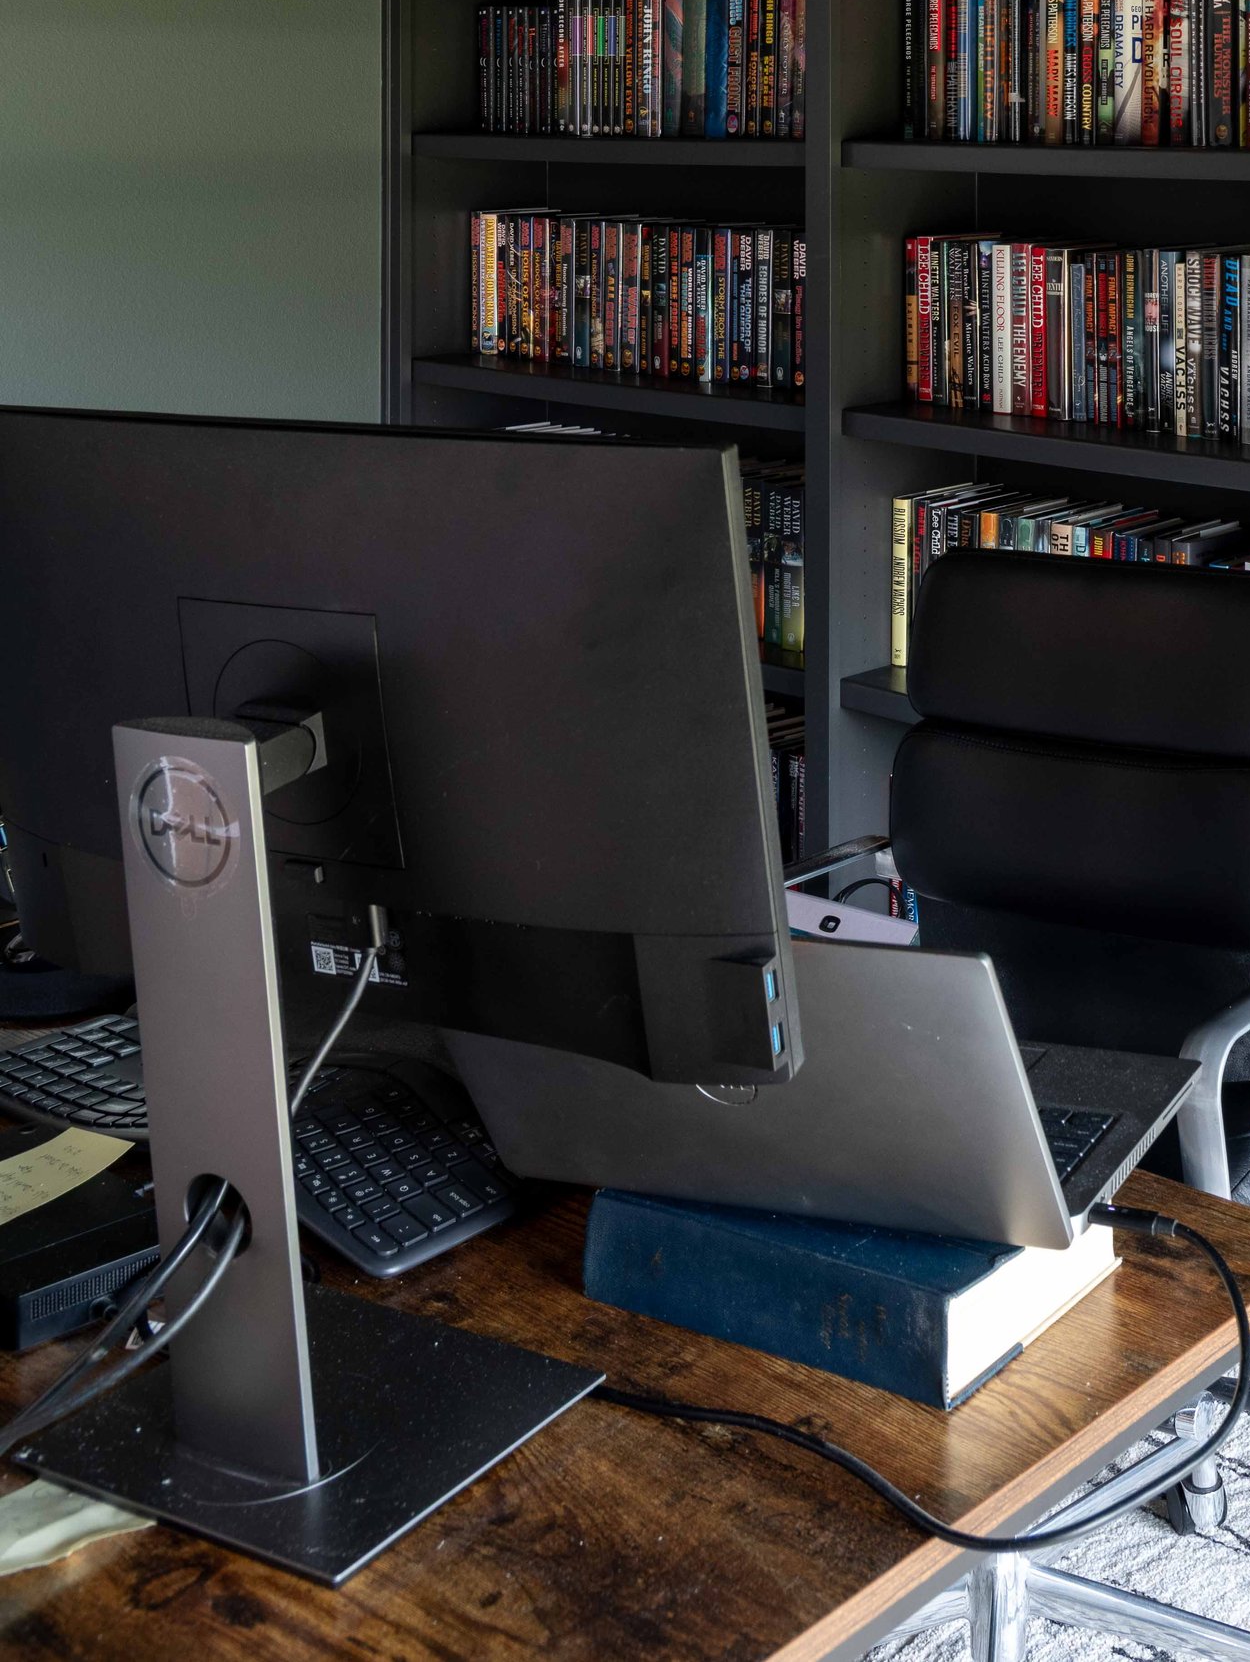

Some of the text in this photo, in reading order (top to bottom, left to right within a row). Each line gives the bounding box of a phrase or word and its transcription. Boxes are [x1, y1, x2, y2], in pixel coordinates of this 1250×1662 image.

[1115, 15, 1123, 88] DRAMA CITY
[1144, 6, 1154, 123] HARD REVOLUTION
[1170, 18, 1182, 128] SOUL CIRCUS
[1082, 83, 1092, 130] COUNTRY
[758, 265, 767, 353] ECHOES OF HONOR
[996, 249, 1004, 332] KILLING FLOOR
[792, 500, 800, 533] DAVID
[894, 509, 905, 545] BLOSSOM
[932, 509, 940, 529] Lee
